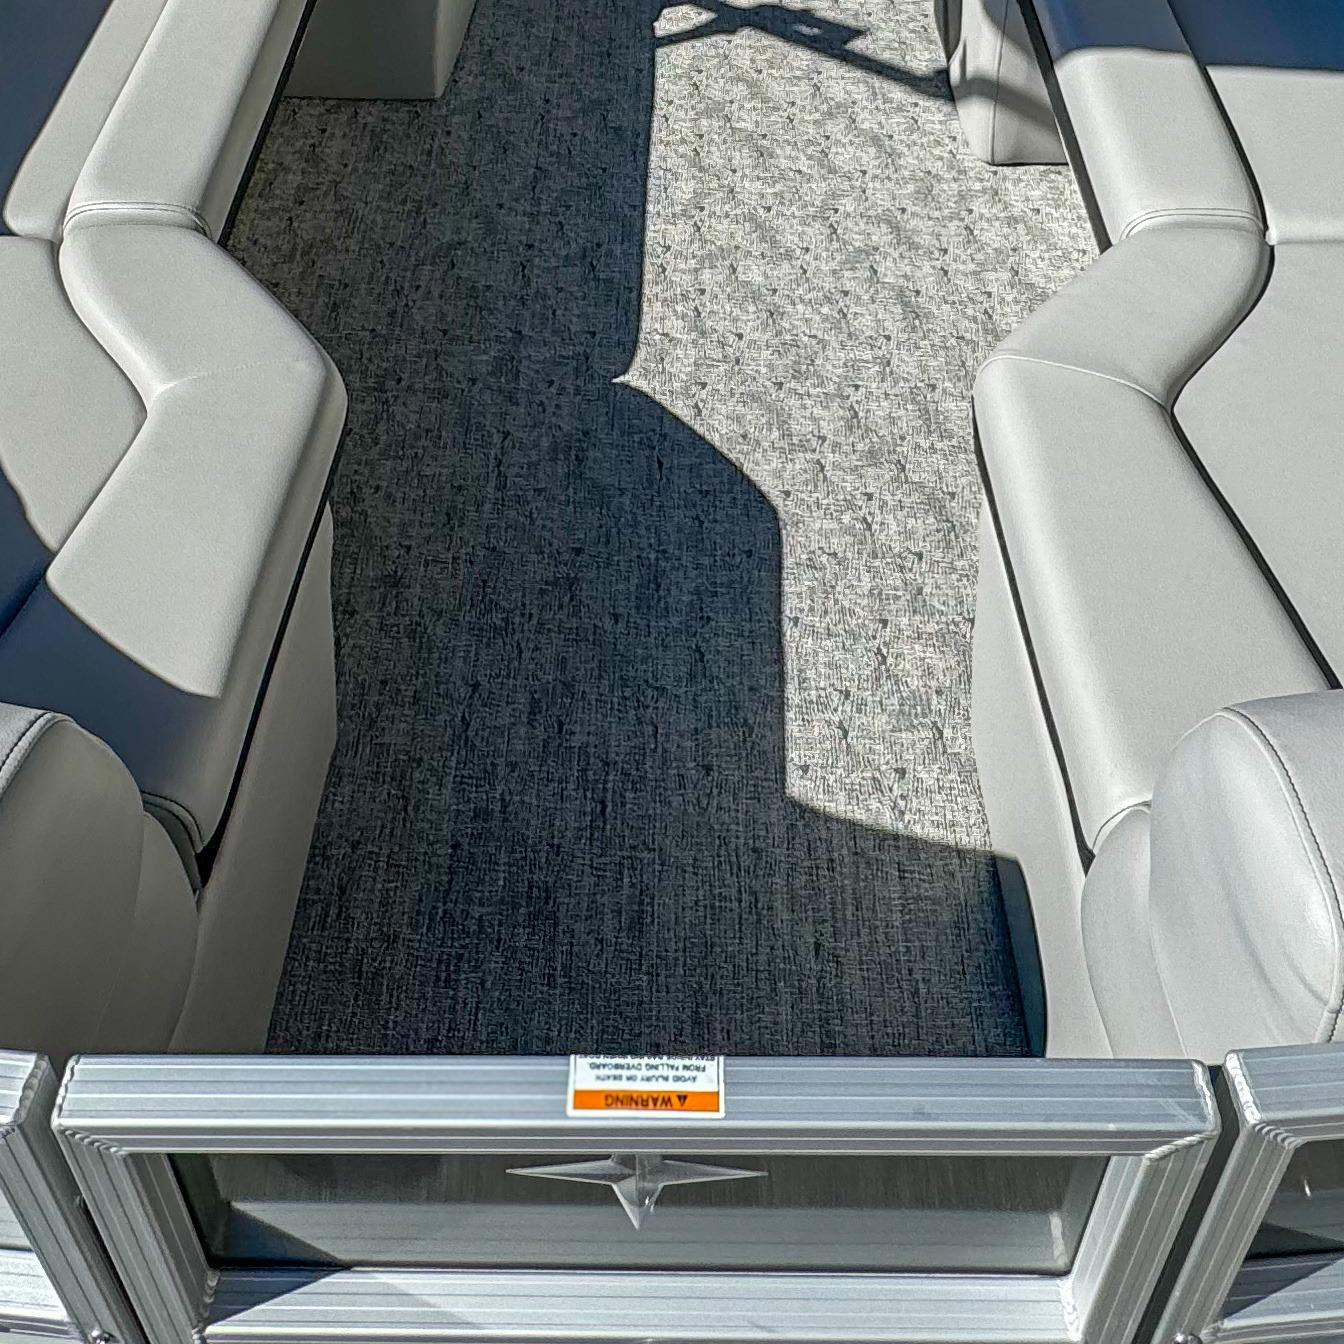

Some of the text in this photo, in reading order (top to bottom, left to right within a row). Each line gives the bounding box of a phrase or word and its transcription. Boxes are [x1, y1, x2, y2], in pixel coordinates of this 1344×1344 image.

[645, 1063, 680, 1072] FALLING
[682, 1064, 706, 1073] FROM
[595, 1074, 697, 1084] AVOID INJURY OR DEATH
[604, 1093, 673, 1108] WARNING
